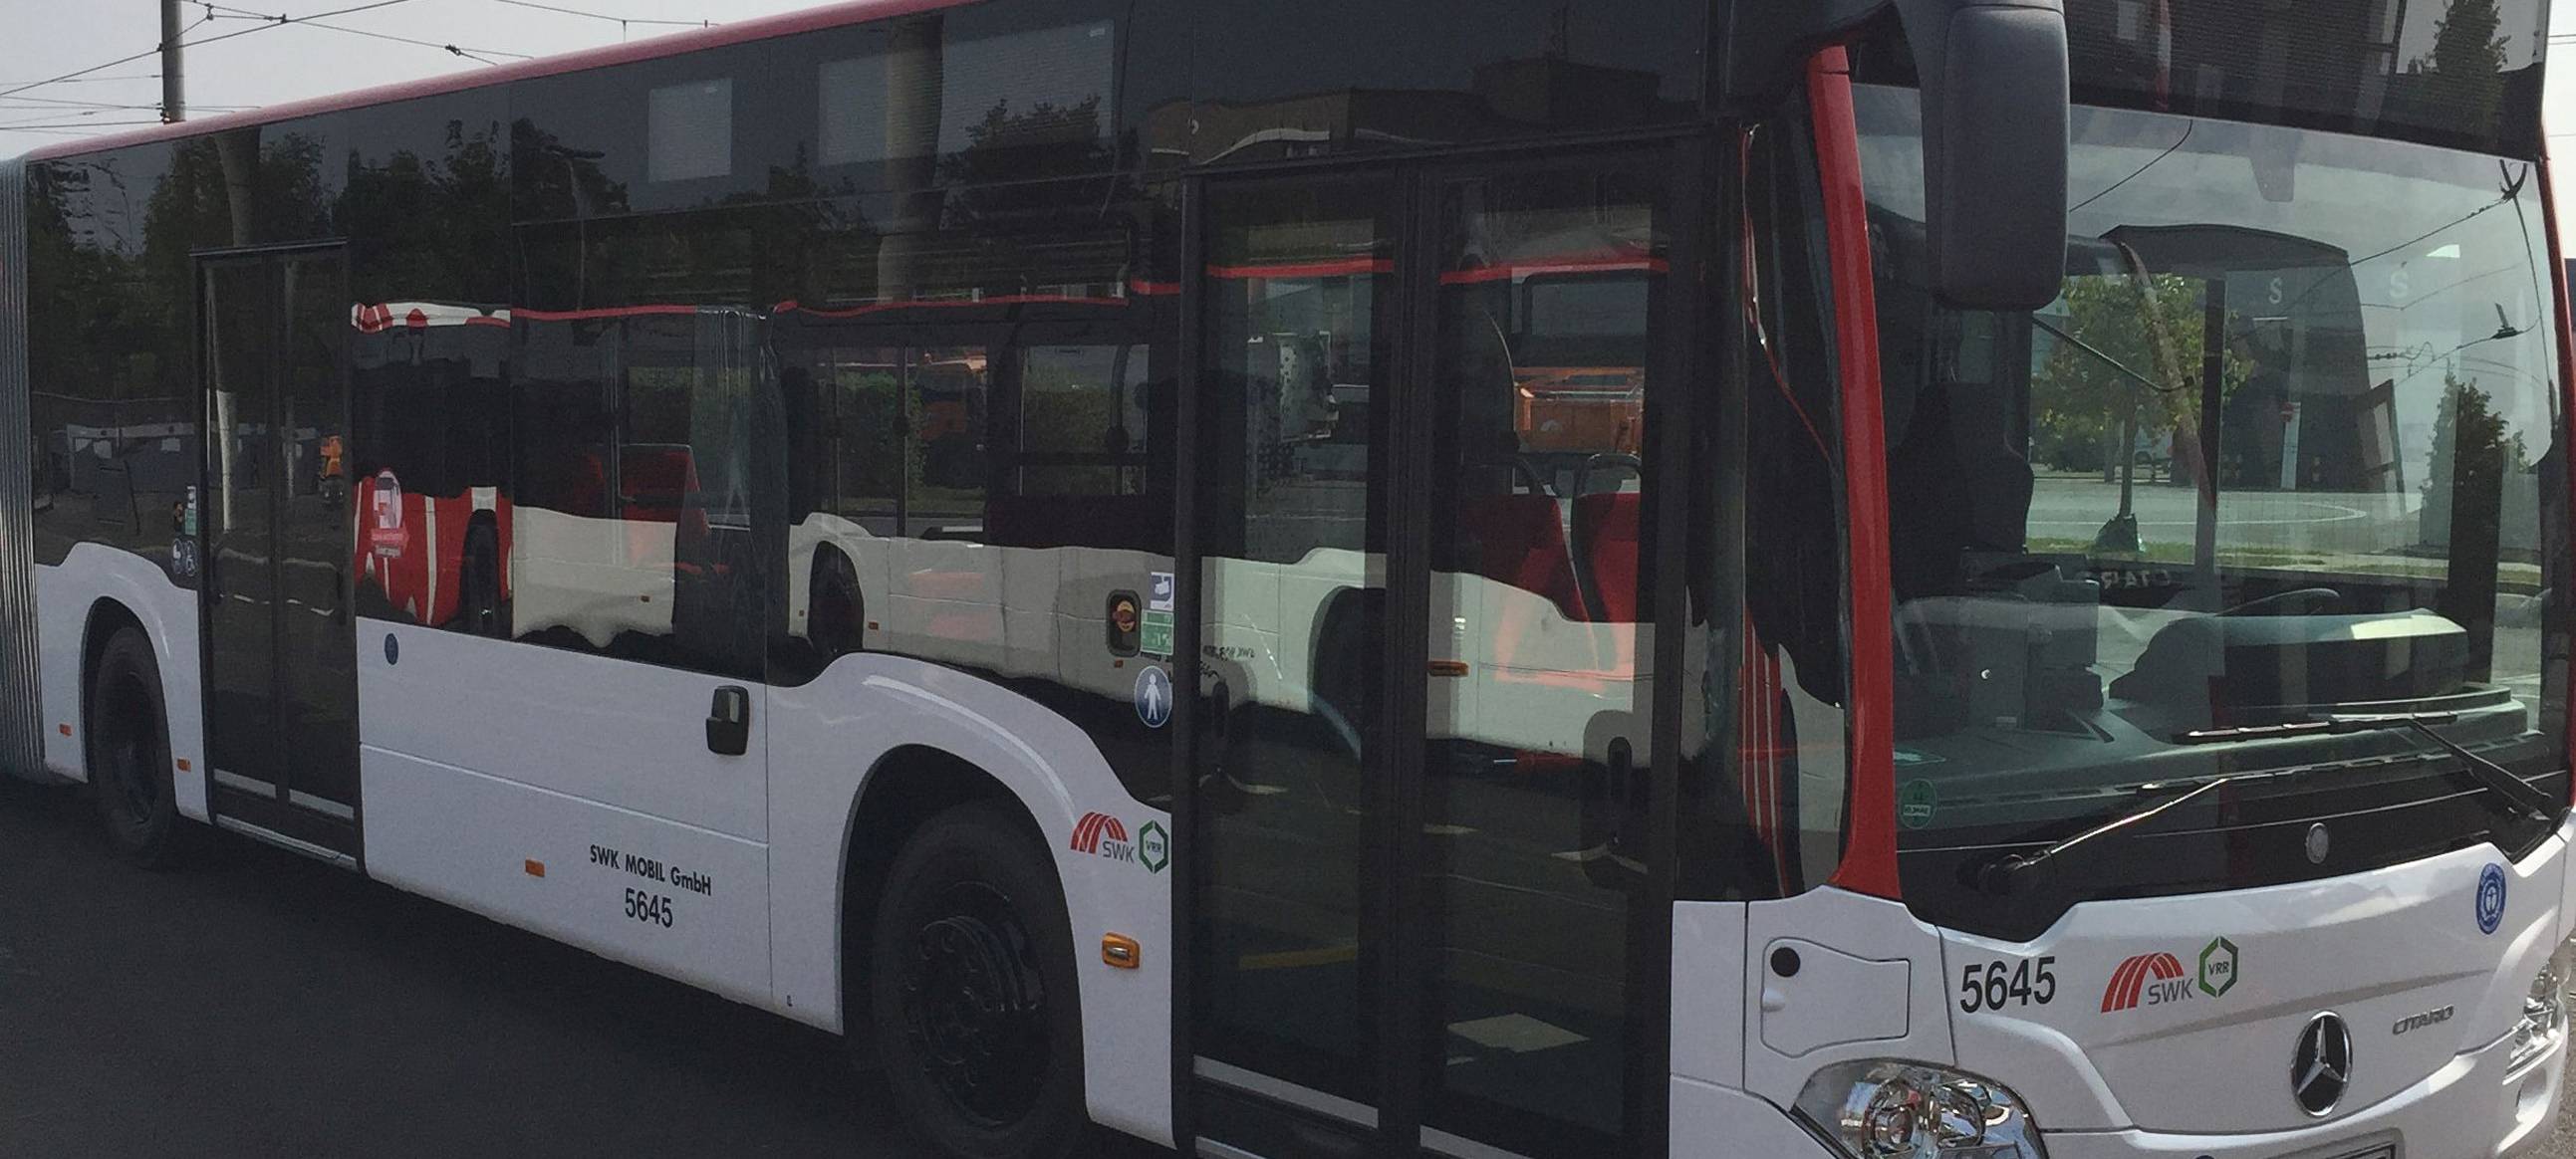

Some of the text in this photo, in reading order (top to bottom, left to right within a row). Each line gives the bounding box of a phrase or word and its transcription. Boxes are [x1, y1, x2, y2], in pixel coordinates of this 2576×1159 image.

[1103, 840, 1135, 863] SWK
[590, 844, 711, 896] SWK MOBIL GmbH
[625, 887, 673, 928] 5645
[1959, 956, 2056, 1014] 5645
[2207, 962, 2230, 976] VRR
[2148, 979, 2193, 1006] SWK
